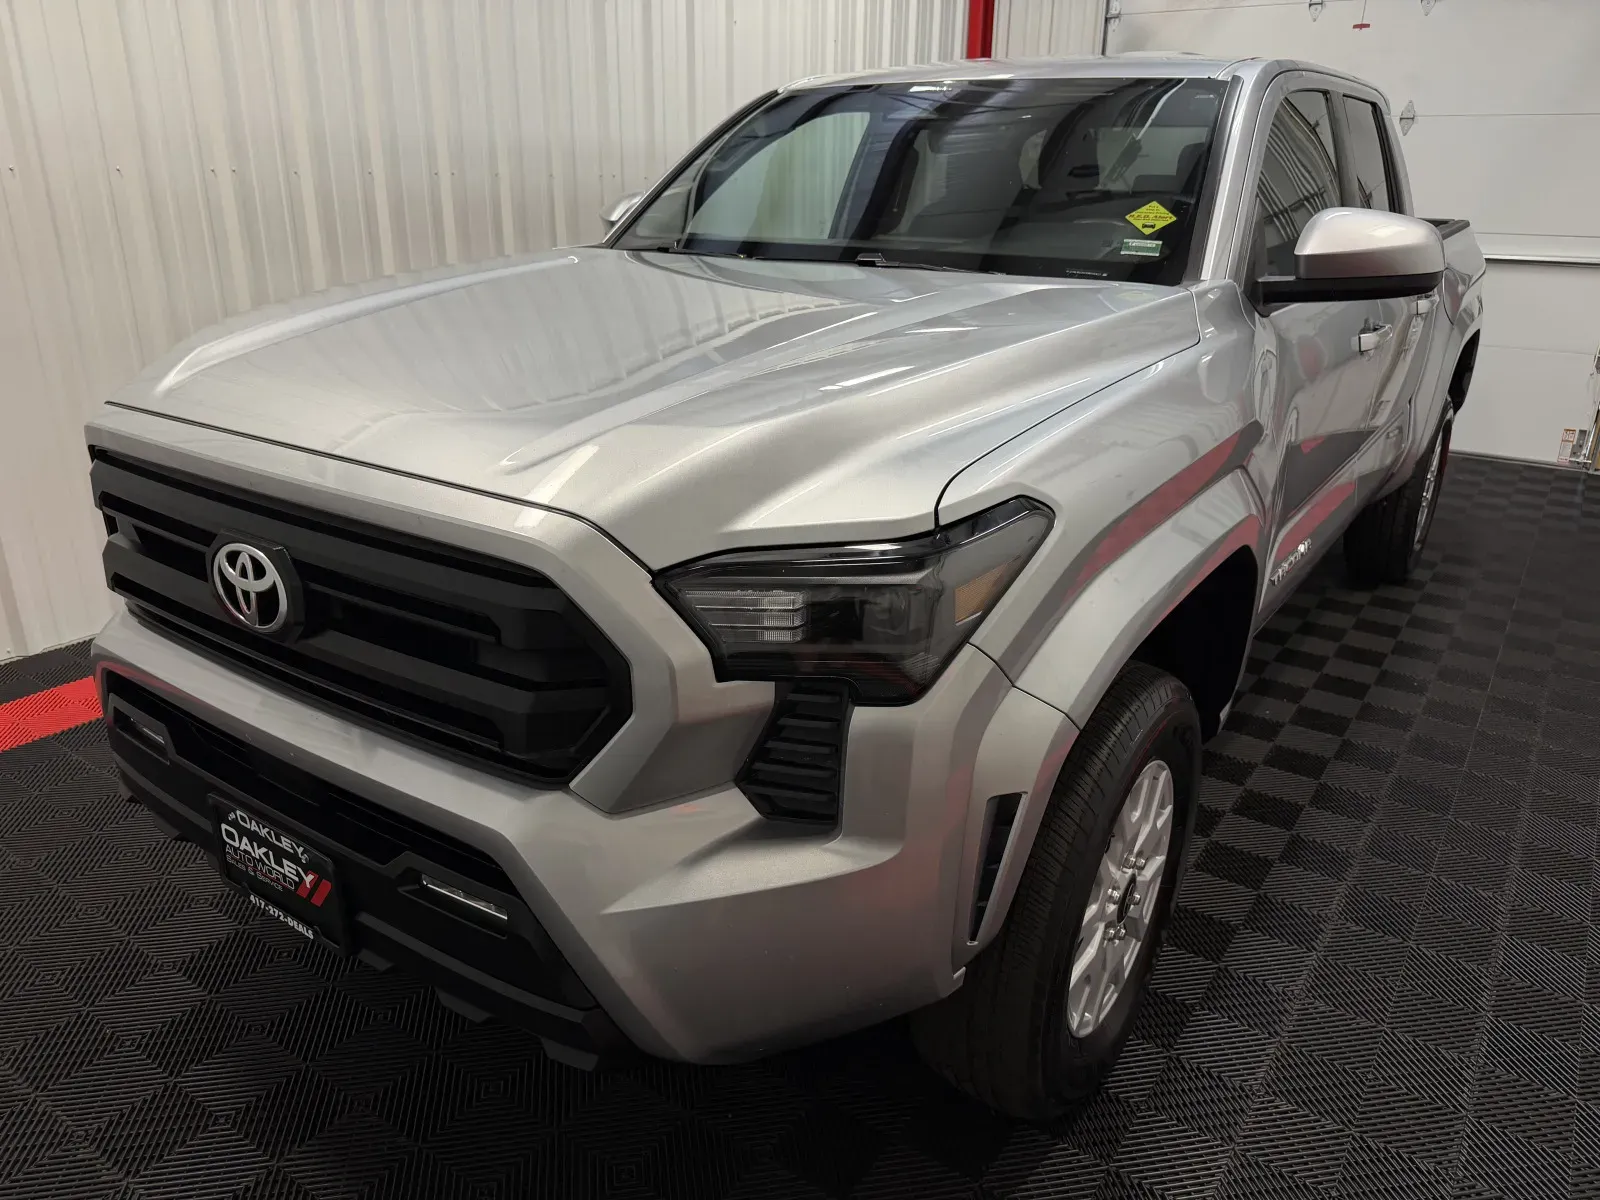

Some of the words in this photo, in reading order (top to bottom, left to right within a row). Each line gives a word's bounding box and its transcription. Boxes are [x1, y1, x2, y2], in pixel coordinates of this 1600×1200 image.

[221, 823, 315, 888] OAKLEY
[236, 810, 304, 858] OAKLEY
[225, 844, 254, 868] AUTO
[255, 861, 295, 890] WORLD
[249, 894, 314, 940] 417-272-DEALS
